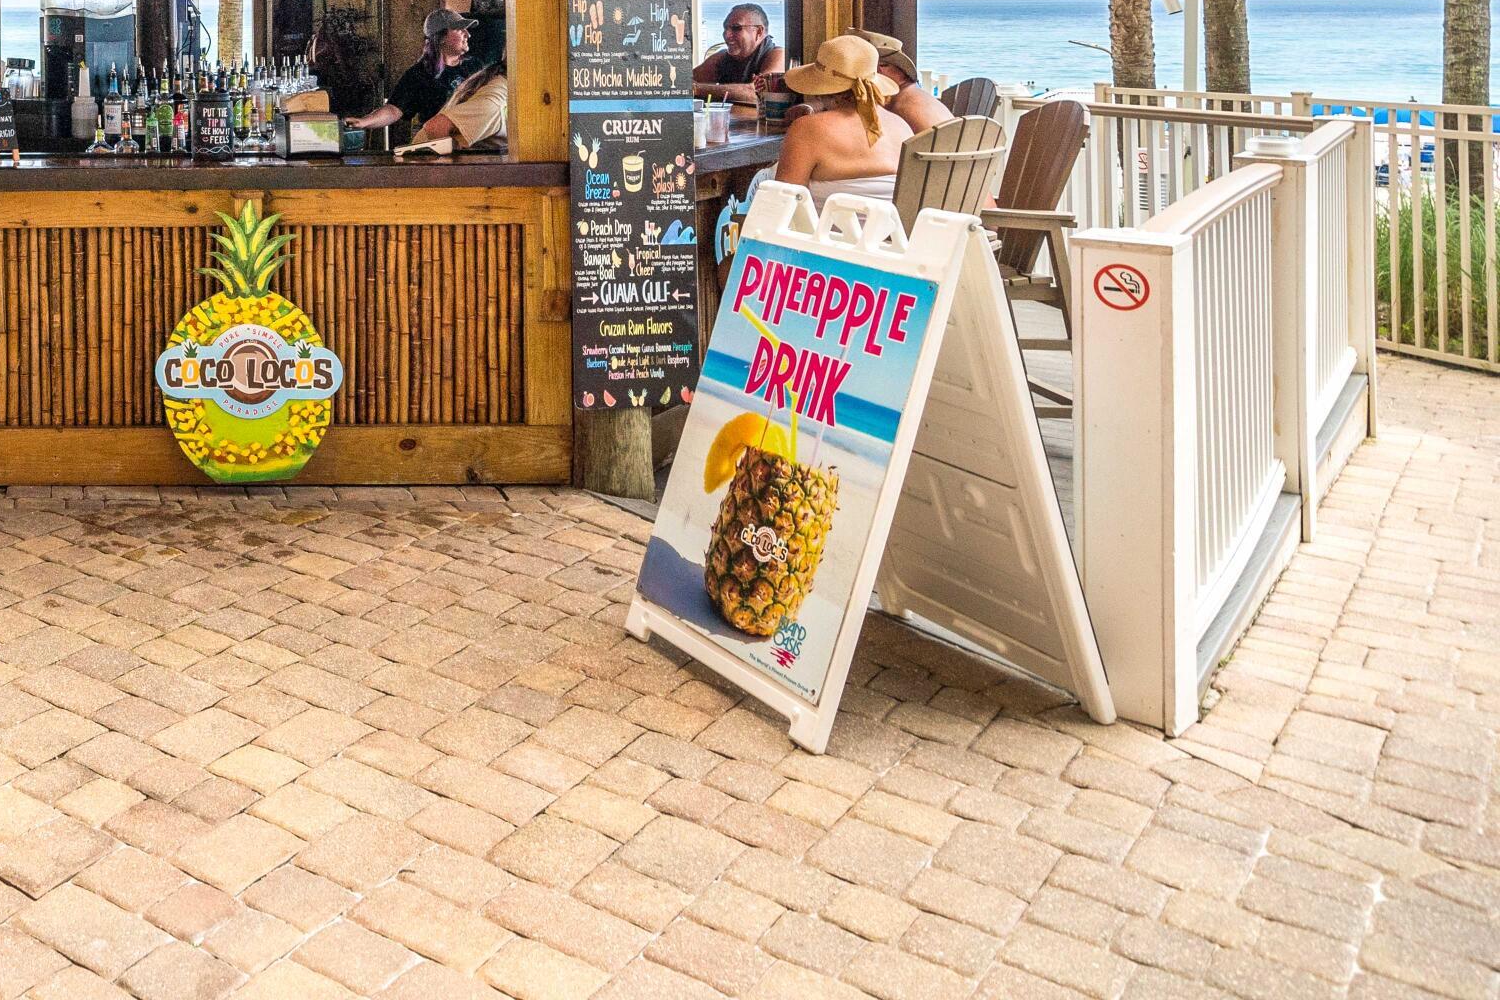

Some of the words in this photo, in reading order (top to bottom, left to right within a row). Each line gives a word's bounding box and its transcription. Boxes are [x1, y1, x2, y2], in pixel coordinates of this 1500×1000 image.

[650, 0, 669, 31] High
[585, 24, 602, 51] Flop
[651, 33, 666, 52] Tide
[573, 68, 590, 88] BCB
[593, 66, 623, 88] Mocha
[626, 66, 663, 88] Mudslide
[202, 108, 215, 118] PUT
[217, 107, 228, 118] THE
[208, 118, 218, 127] TIP
[220, 118, 227, 127] IN
[201, 127, 211, 135] SEE
[212, 127, 225, 135] HOW
[602, 119, 662, 136] CRUZAN
[210, 135, 230, 144] FEELS
[586, 169, 610, 185] Ocean
[652, 175, 675, 199] Splash
[585, 185, 611, 200] Breeze
[590, 218, 612, 236] Peach
[615, 219, 632, 241] Drop
[583, 251, 611, 269] Banana
[636, 245, 661, 265] Tropical
[599, 264, 616, 281] Boat
[635, 263, 655, 276] Cheer
[600, 281, 639, 305] GUAVA
[642, 279, 671, 303] GULF
[732, 254, 917, 358] PINEAPPLE
[600, 320, 627, 337] Cruzan
[628, 319, 644, 336] Rum
[647, 316, 673, 335] Flavors
[219, 331, 240, 349] PURE
[251, 328, 283, 350] SIMPLE
[165, 358, 235, 389] COCO
[246, 358, 334, 390] LOCOS
[744, 335, 852, 428] DRINK
[222, 399, 279, 416] PARADISE
[773, 631, 803, 656] OASIS
